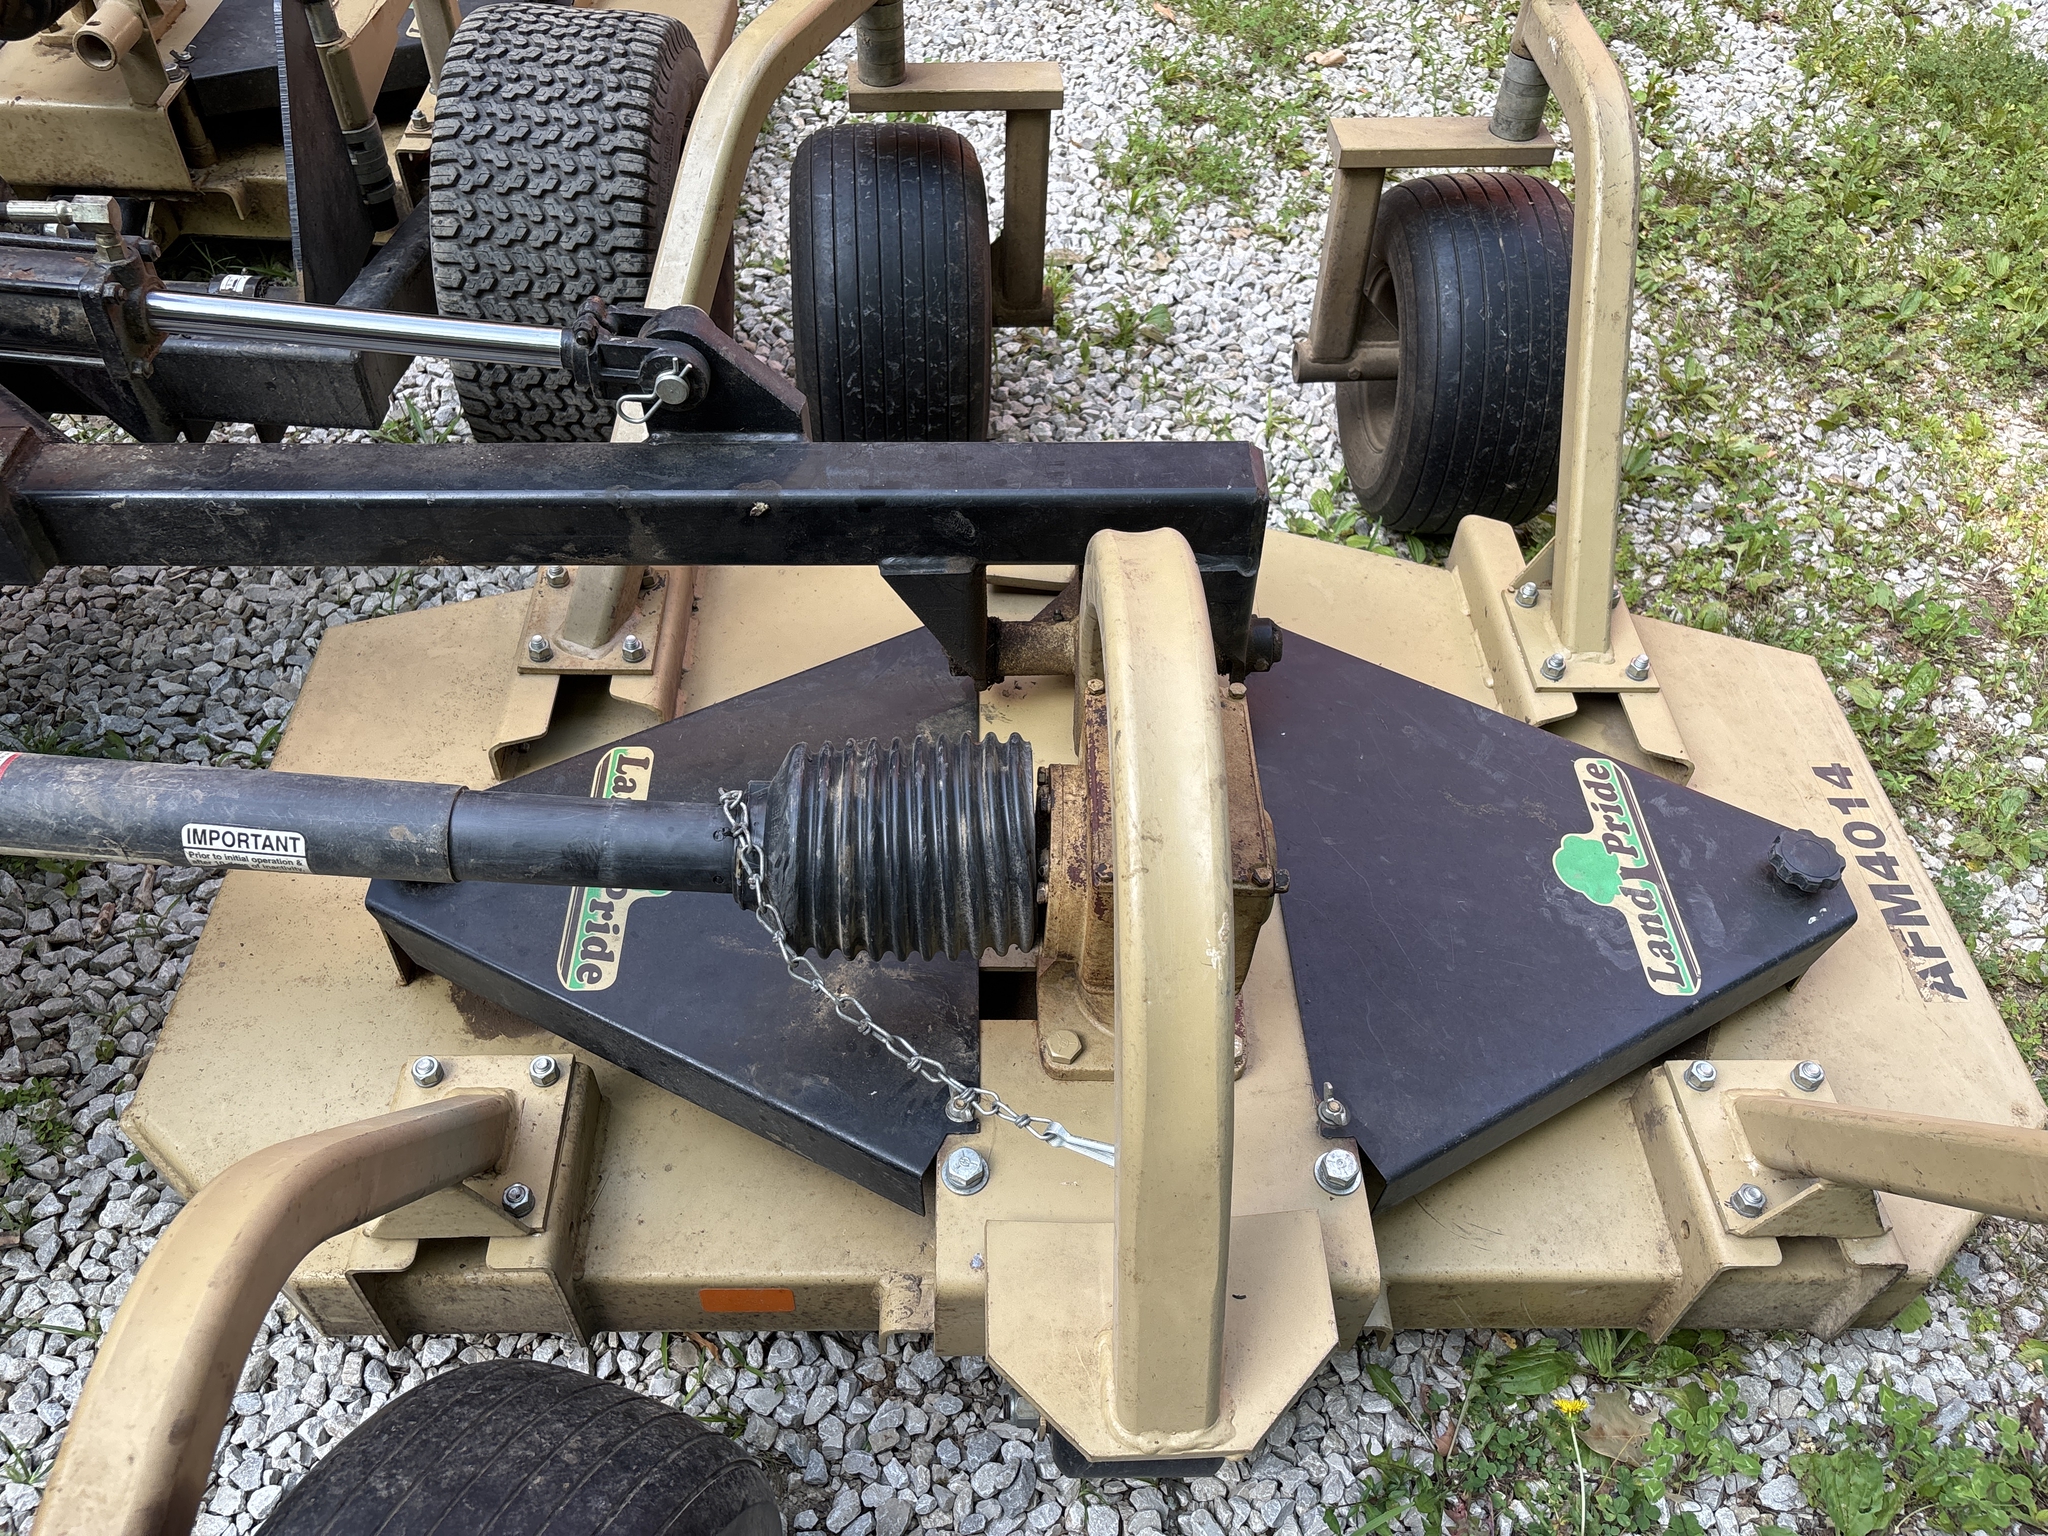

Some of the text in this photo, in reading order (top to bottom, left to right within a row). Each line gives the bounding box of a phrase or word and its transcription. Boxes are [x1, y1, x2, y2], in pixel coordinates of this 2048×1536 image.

[186, 827, 301, 853] IMPORTANT
[188, 850, 210, 859] Prior
[224, 854, 249, 862] initial
[251, 857, 294, 866] operation
[1582, 762, 1687, 988] Land Pride
[1811, 763, 1969, 1000] AFM4014
